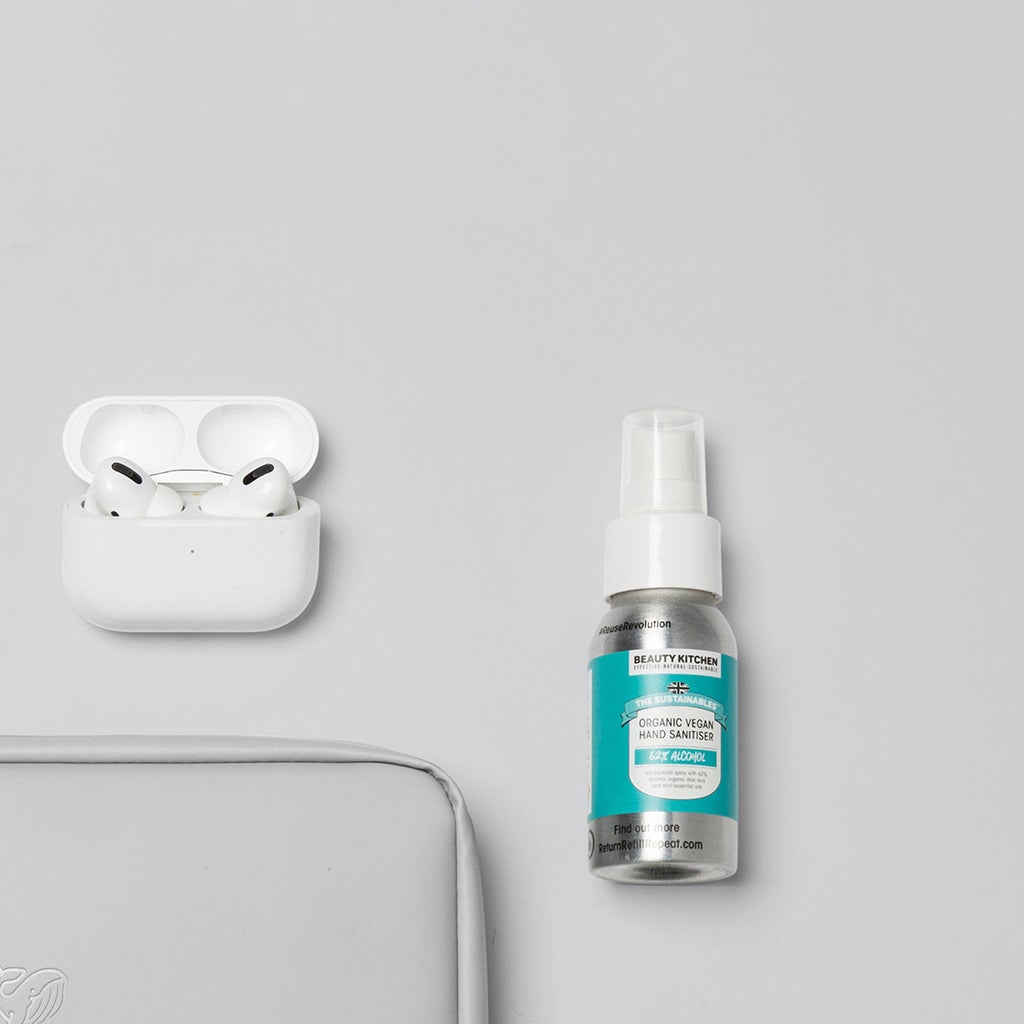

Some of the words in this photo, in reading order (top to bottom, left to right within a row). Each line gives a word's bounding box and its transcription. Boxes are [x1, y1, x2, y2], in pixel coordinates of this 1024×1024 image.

[634, 655, 676, 664] BEAUTY
[678, 655, 718, 666] KITCHEN
[635, 699, 653, 708] THE
[639, 718, 682, 727] ORGANIC
[686, 719, 713, 729] VEGAN
[639, 730, 666, 739] HAND
[649, 750, 670, 761] 62%
[671, 751, 706, 763] ALCOHOL
[614, 825, 631, 835] Find
